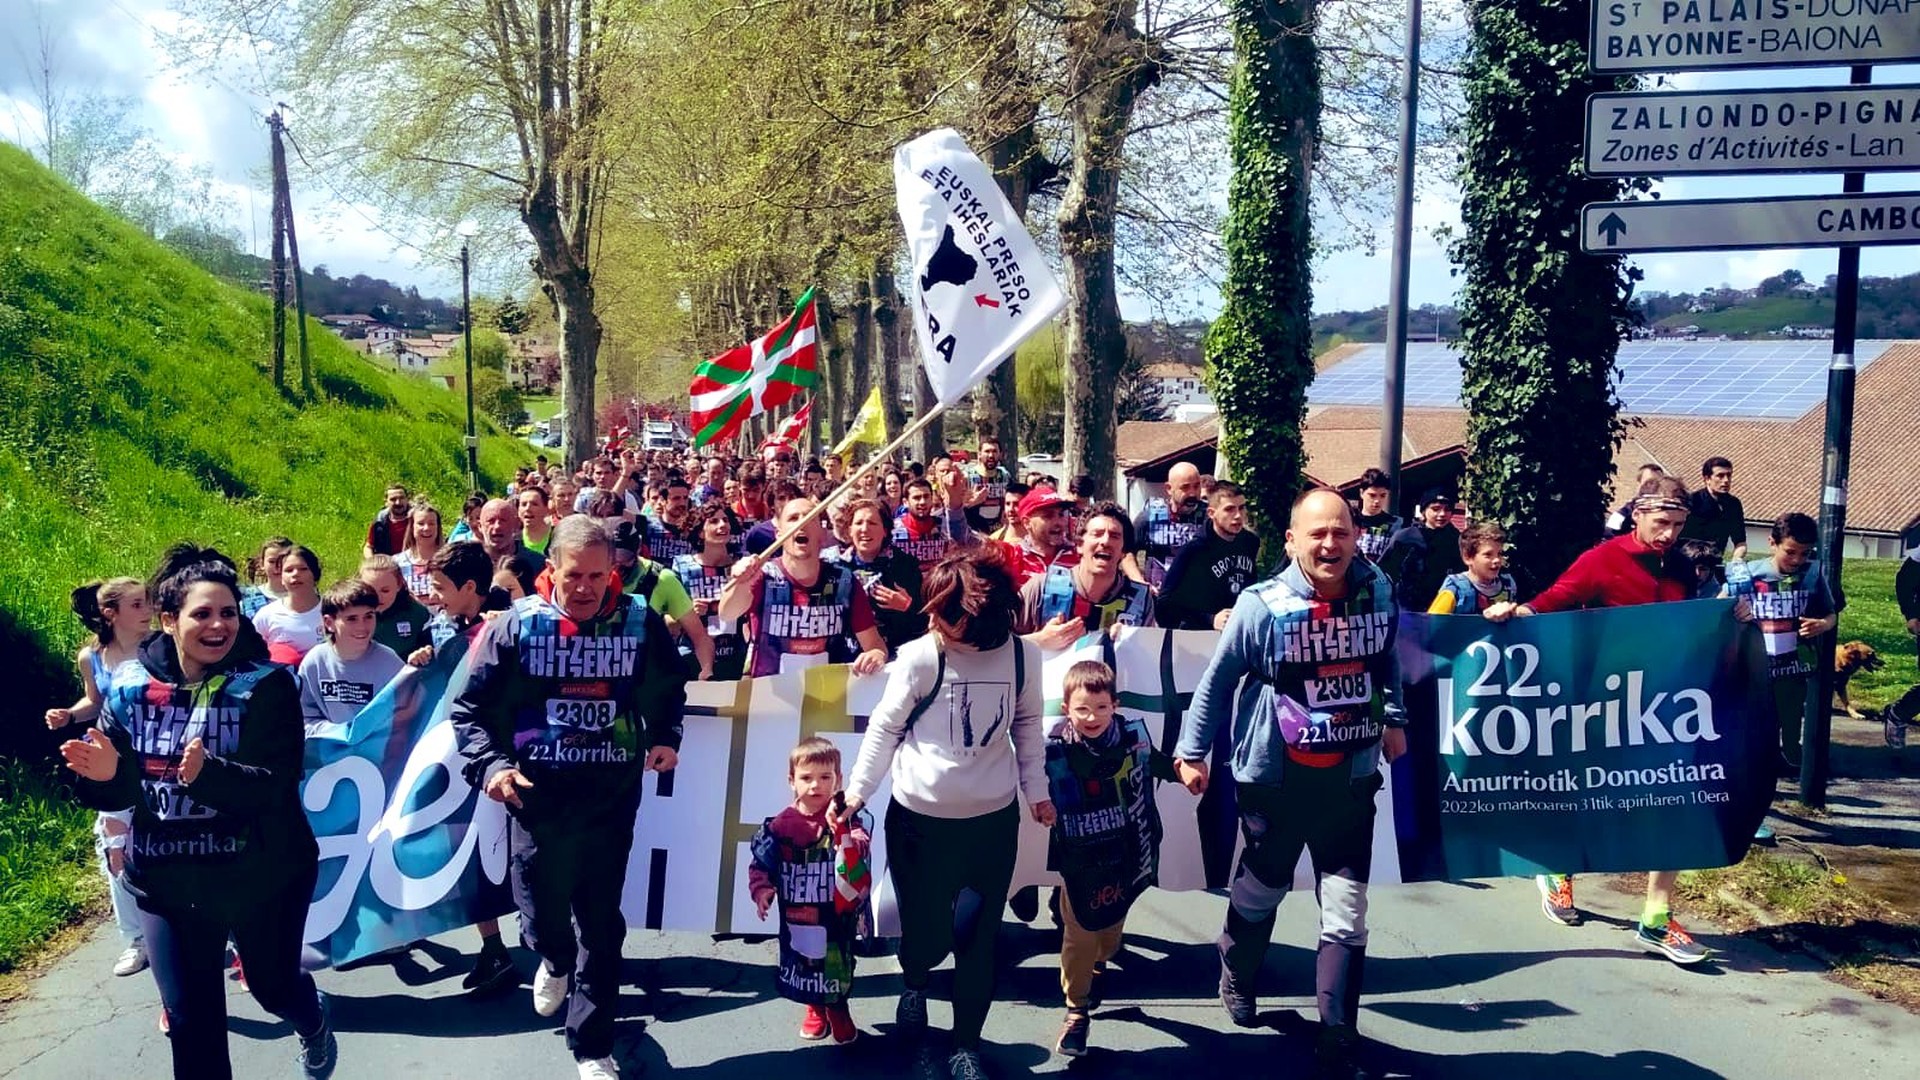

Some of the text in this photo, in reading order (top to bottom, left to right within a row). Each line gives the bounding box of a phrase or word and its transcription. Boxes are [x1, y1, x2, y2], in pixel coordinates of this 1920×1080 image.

[1608, 25, 1882, 58] BAYONNE-BAIONA
[1601, 139, 1678, 162] Zones
[921, 169, 1022, 317] ETA IHESLARIAK
[938, 166, 1030, 301] EUSKAL PRESO
[922, 296, 957, 364] RA
[529, 635, 638, 678] HITZEKIN
[1465, 641, 1561, 697] 22.
[1314, 672, 1366, 702] 2308
[556, 702, 611, 728] 2308
[1437, 670, 1723, 757] korrika
[1443, 759, 1726, 793] Amurriotik Donostiara
[1441, 800, 1495, 813] 2022ko
[1498, 800, 1578, 812] martxoaren
[1618, 793, 1686, 812] apirilaren
[1691, 790, 1730, 804] 10era
